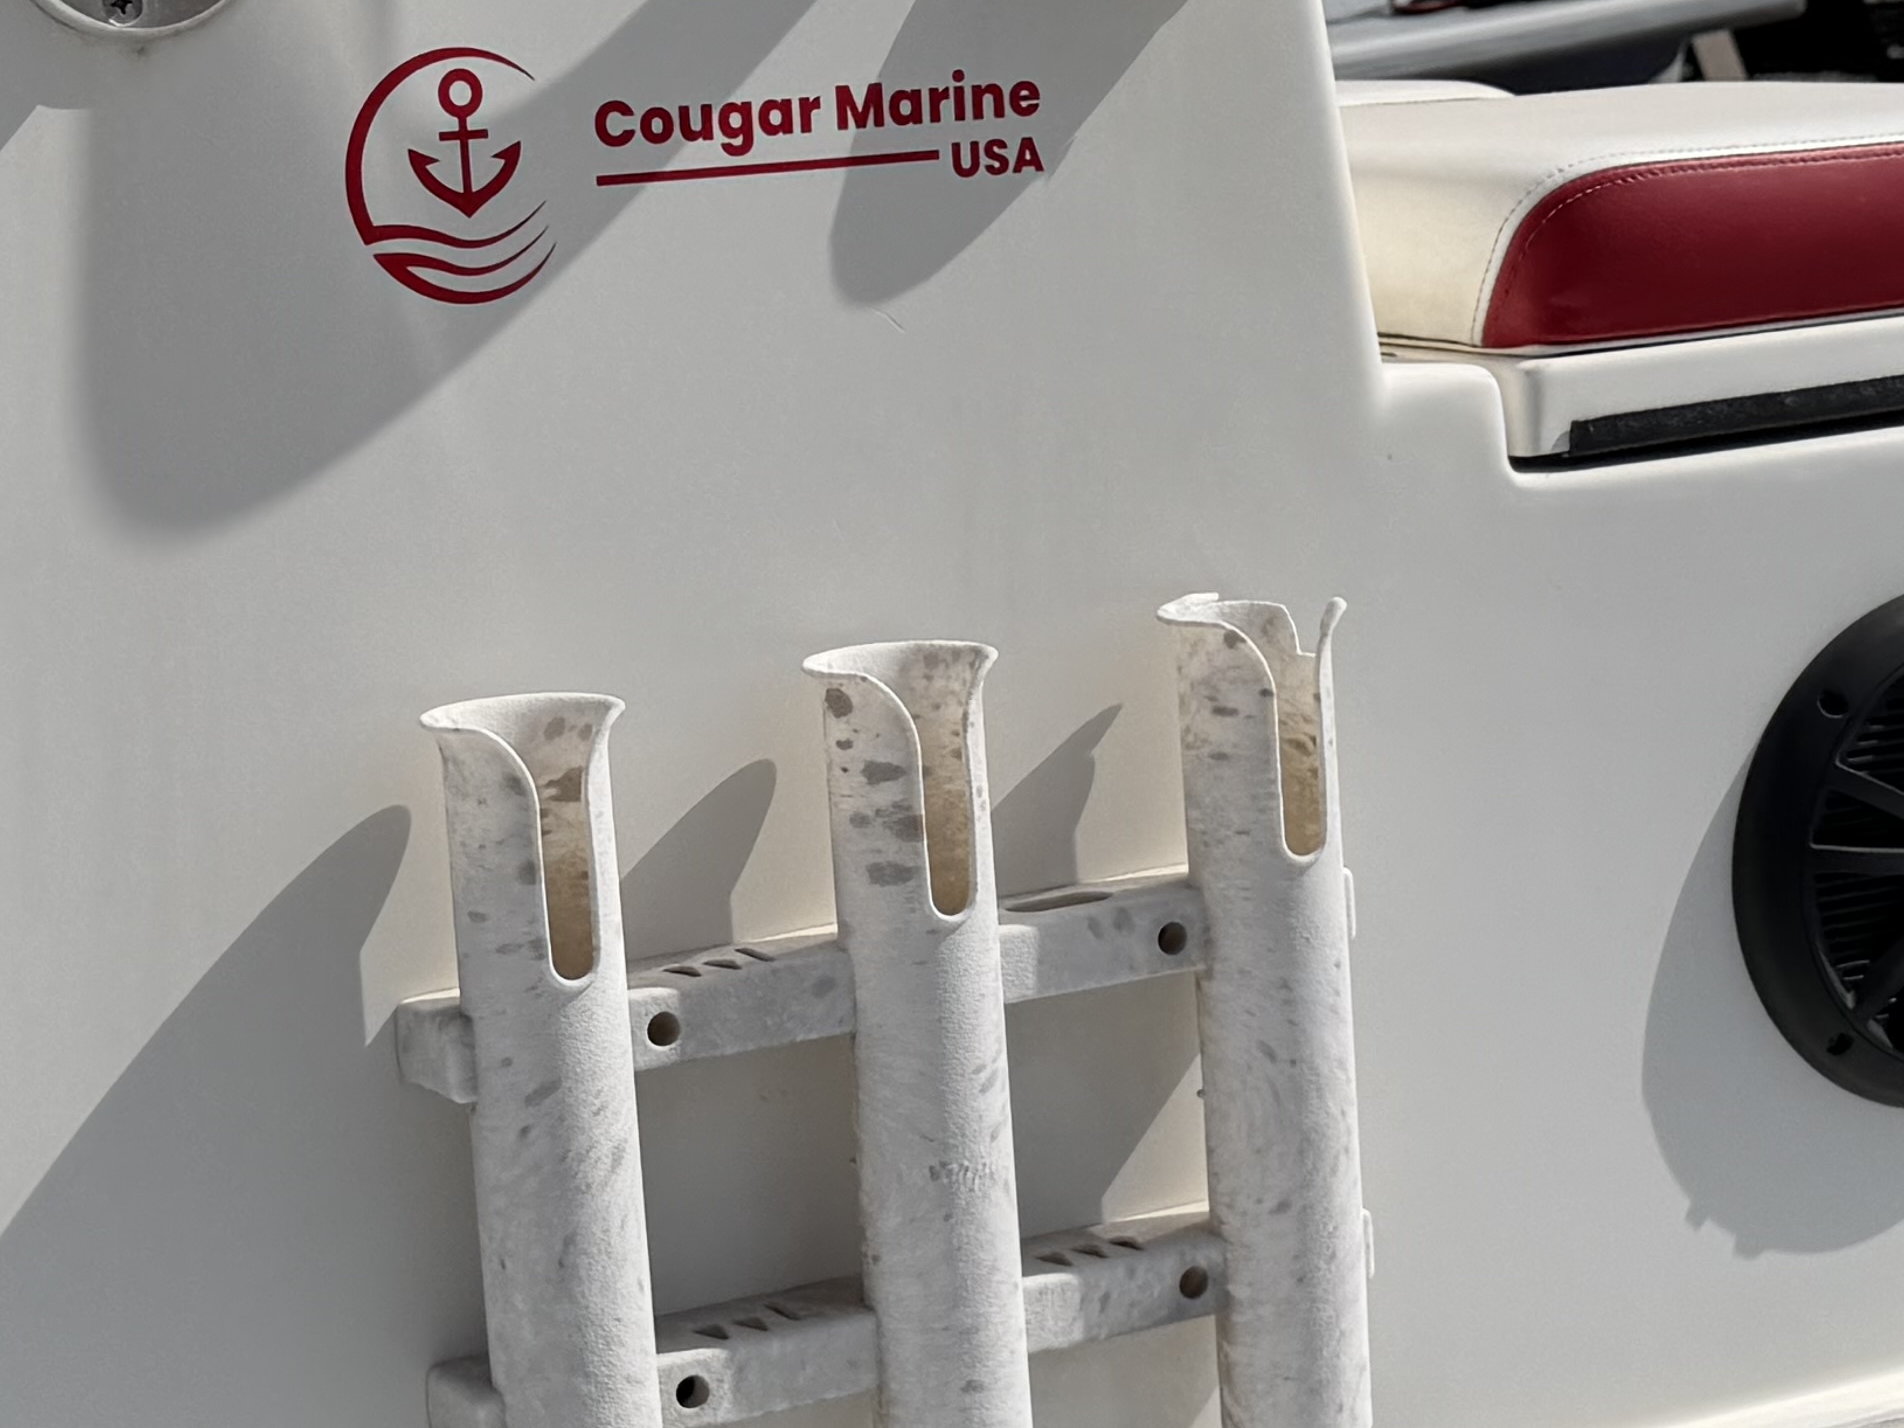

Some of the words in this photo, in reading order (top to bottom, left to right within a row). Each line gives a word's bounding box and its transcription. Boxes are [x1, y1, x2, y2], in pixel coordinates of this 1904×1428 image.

[594, 98, 821, 157] Cougar
[834, 68, 1041, 131] Marine
[950, 136, 1045, 178] USA
